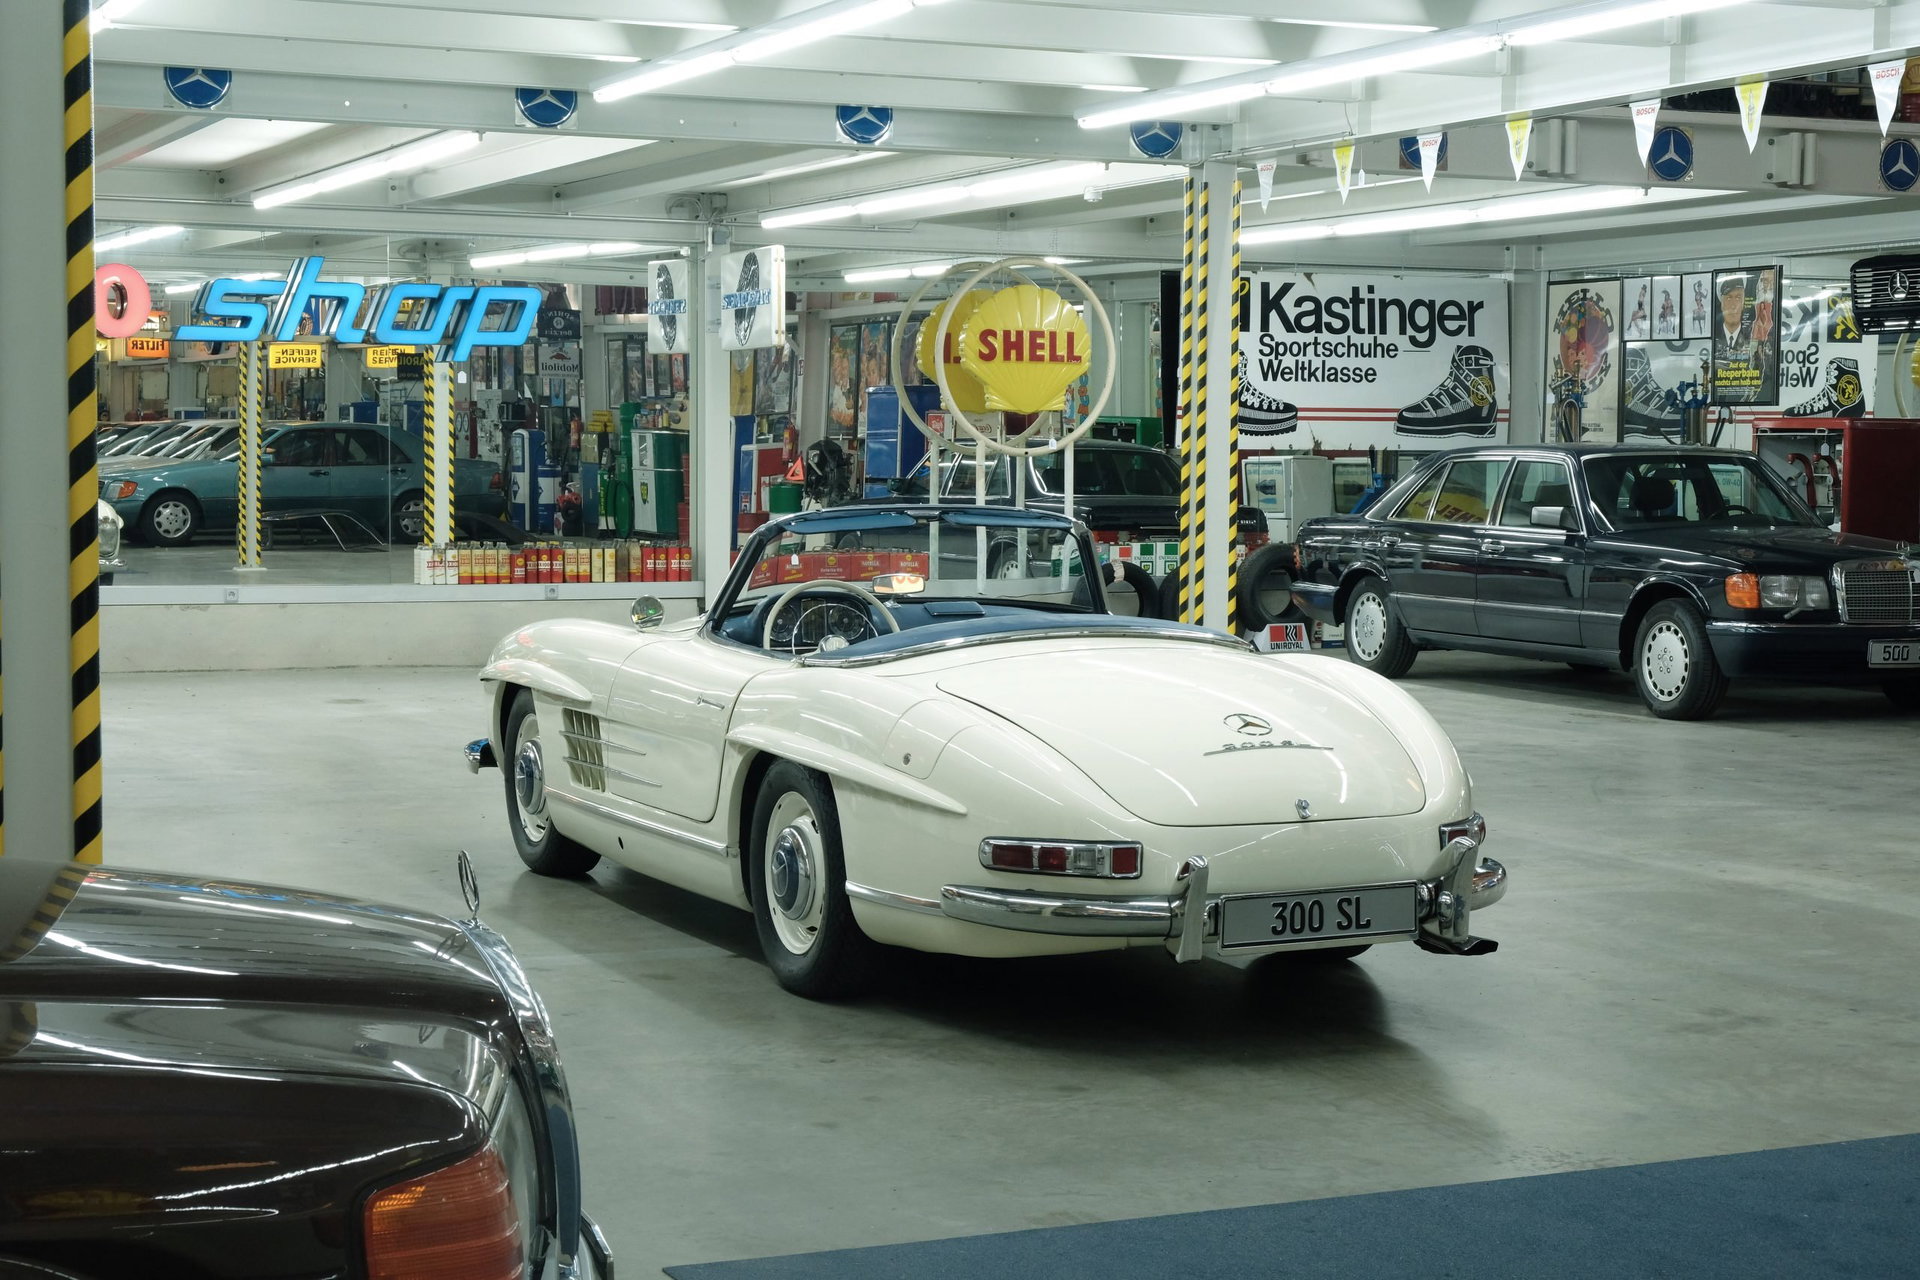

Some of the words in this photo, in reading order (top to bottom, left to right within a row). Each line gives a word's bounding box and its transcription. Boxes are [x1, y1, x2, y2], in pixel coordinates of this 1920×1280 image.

[1875, 68, 1900, 79] BOSCH
[1635, 106, 1656, 116] BOSCH
[1421, 138, 1439, 148] BOSCH
[174, 256, 542, 362] shop
[1260, 281, 1484, 348] Kastinger
[978, 328, 1082, 363] SHELL
[1258, 333, 1398, 361] Sportschuhe
[1259, 359, 1377, 383] Weltklasse
[1717, 368, 1760, 380] Reeperbahn
[1270, 642, 1304, 650] UNIROYAL
[1882, 645, 1910, 661] 500
[1270, 900, 1325, 936] 300
[1336, 896, 1372, 931] SL
